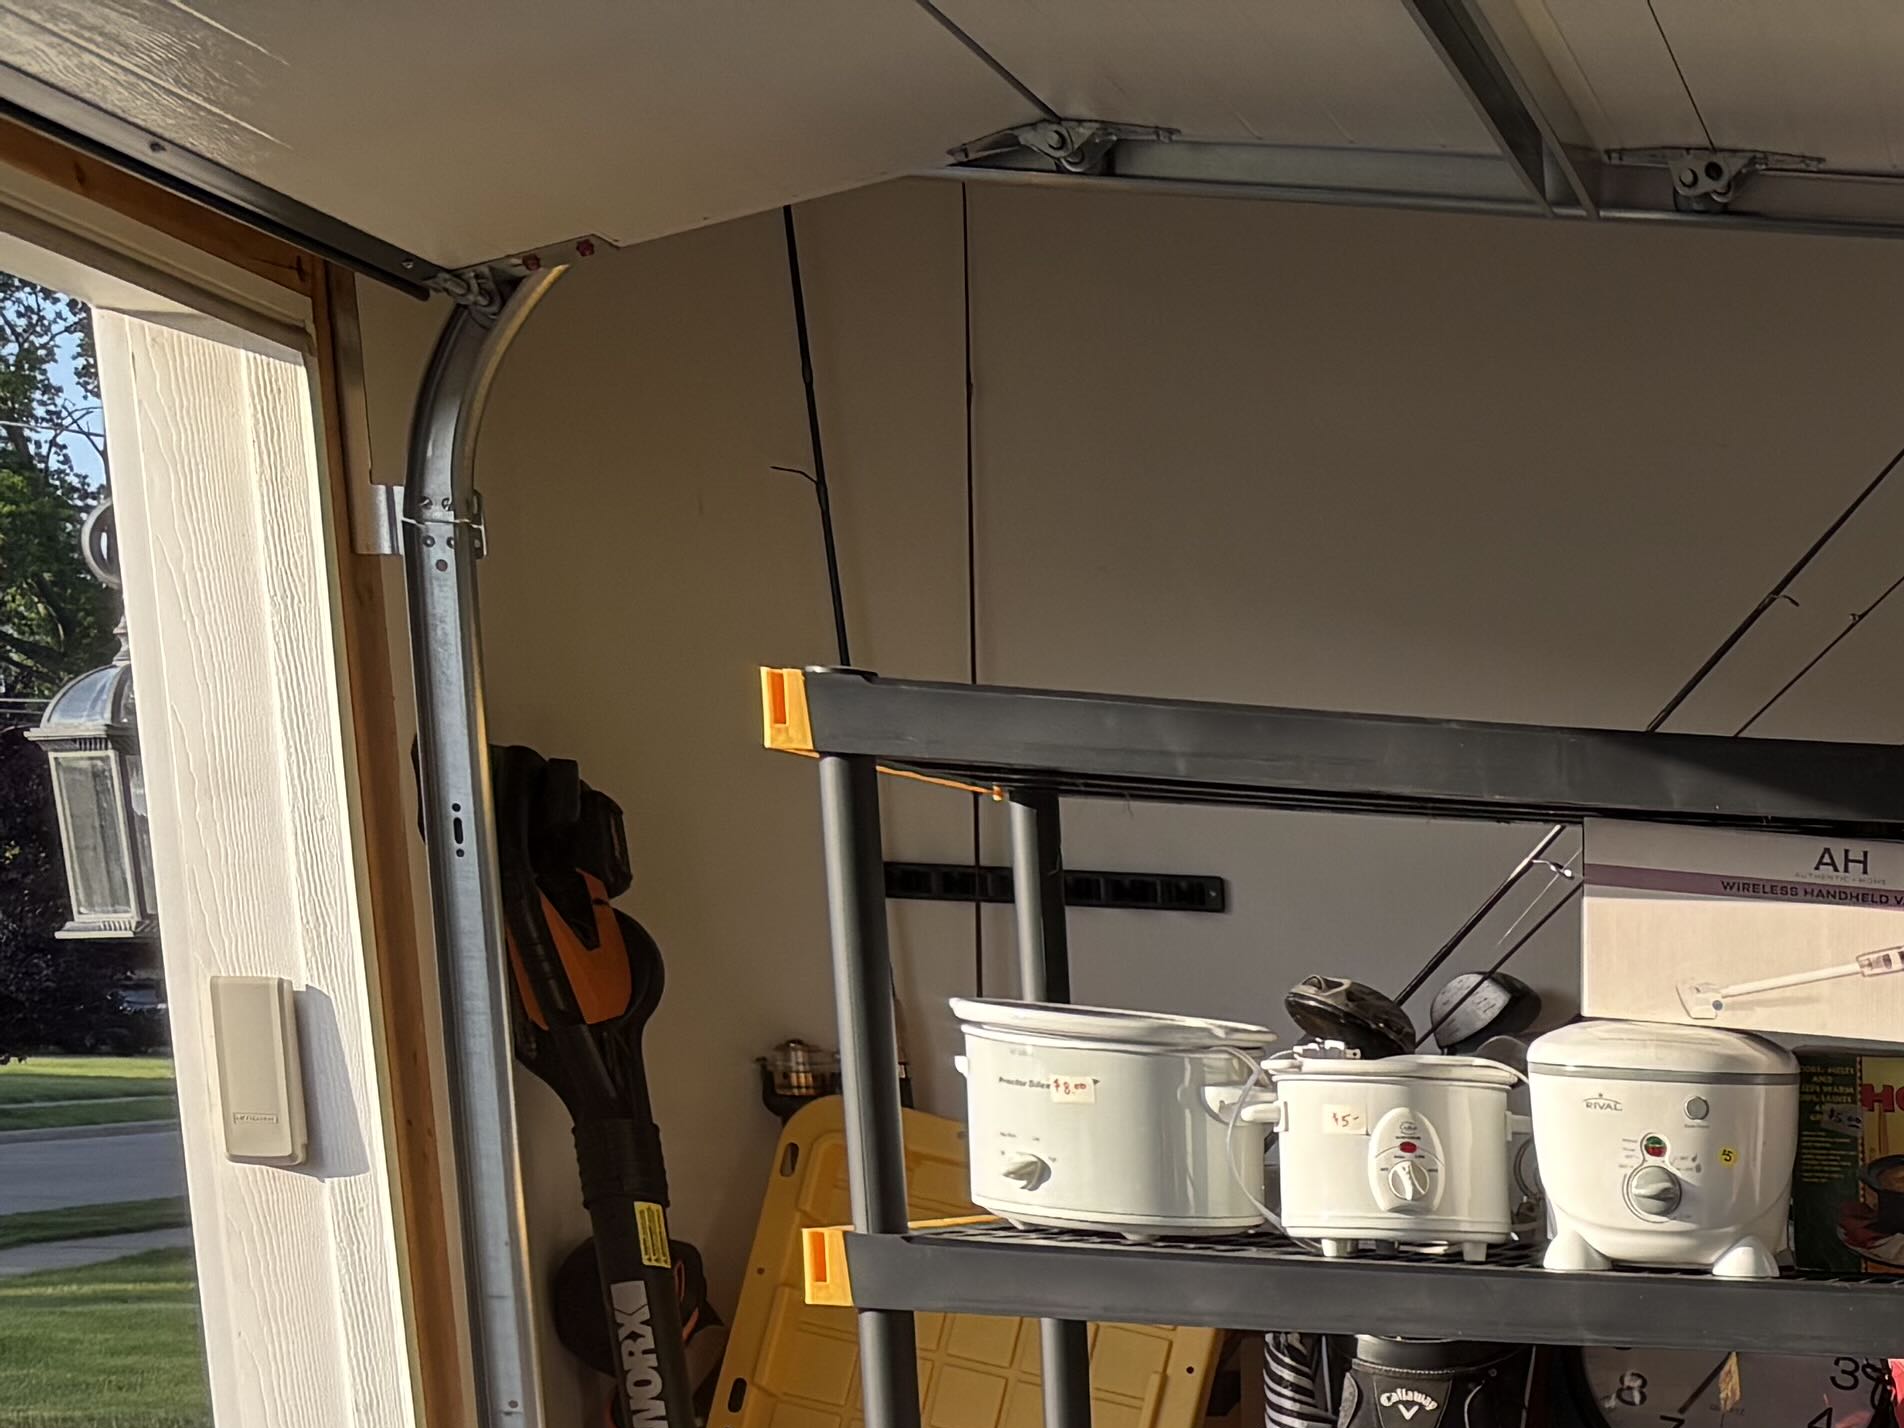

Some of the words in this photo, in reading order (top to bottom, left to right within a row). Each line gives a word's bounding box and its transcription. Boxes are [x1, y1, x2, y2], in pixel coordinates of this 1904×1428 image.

[1814, 847, 1869, 875] AH
[1721, 880, 1799, 897] WIRELESS
[1803, 885, 1890, 905] HANDHELD
[1585, 1101, 1624, 1113] RIVAL
[1829, 1356, 1860, 1391] 3
[1379, 1386, 1440, 1411] Callaway
[1616, 1372, 1648, 1407] 8
